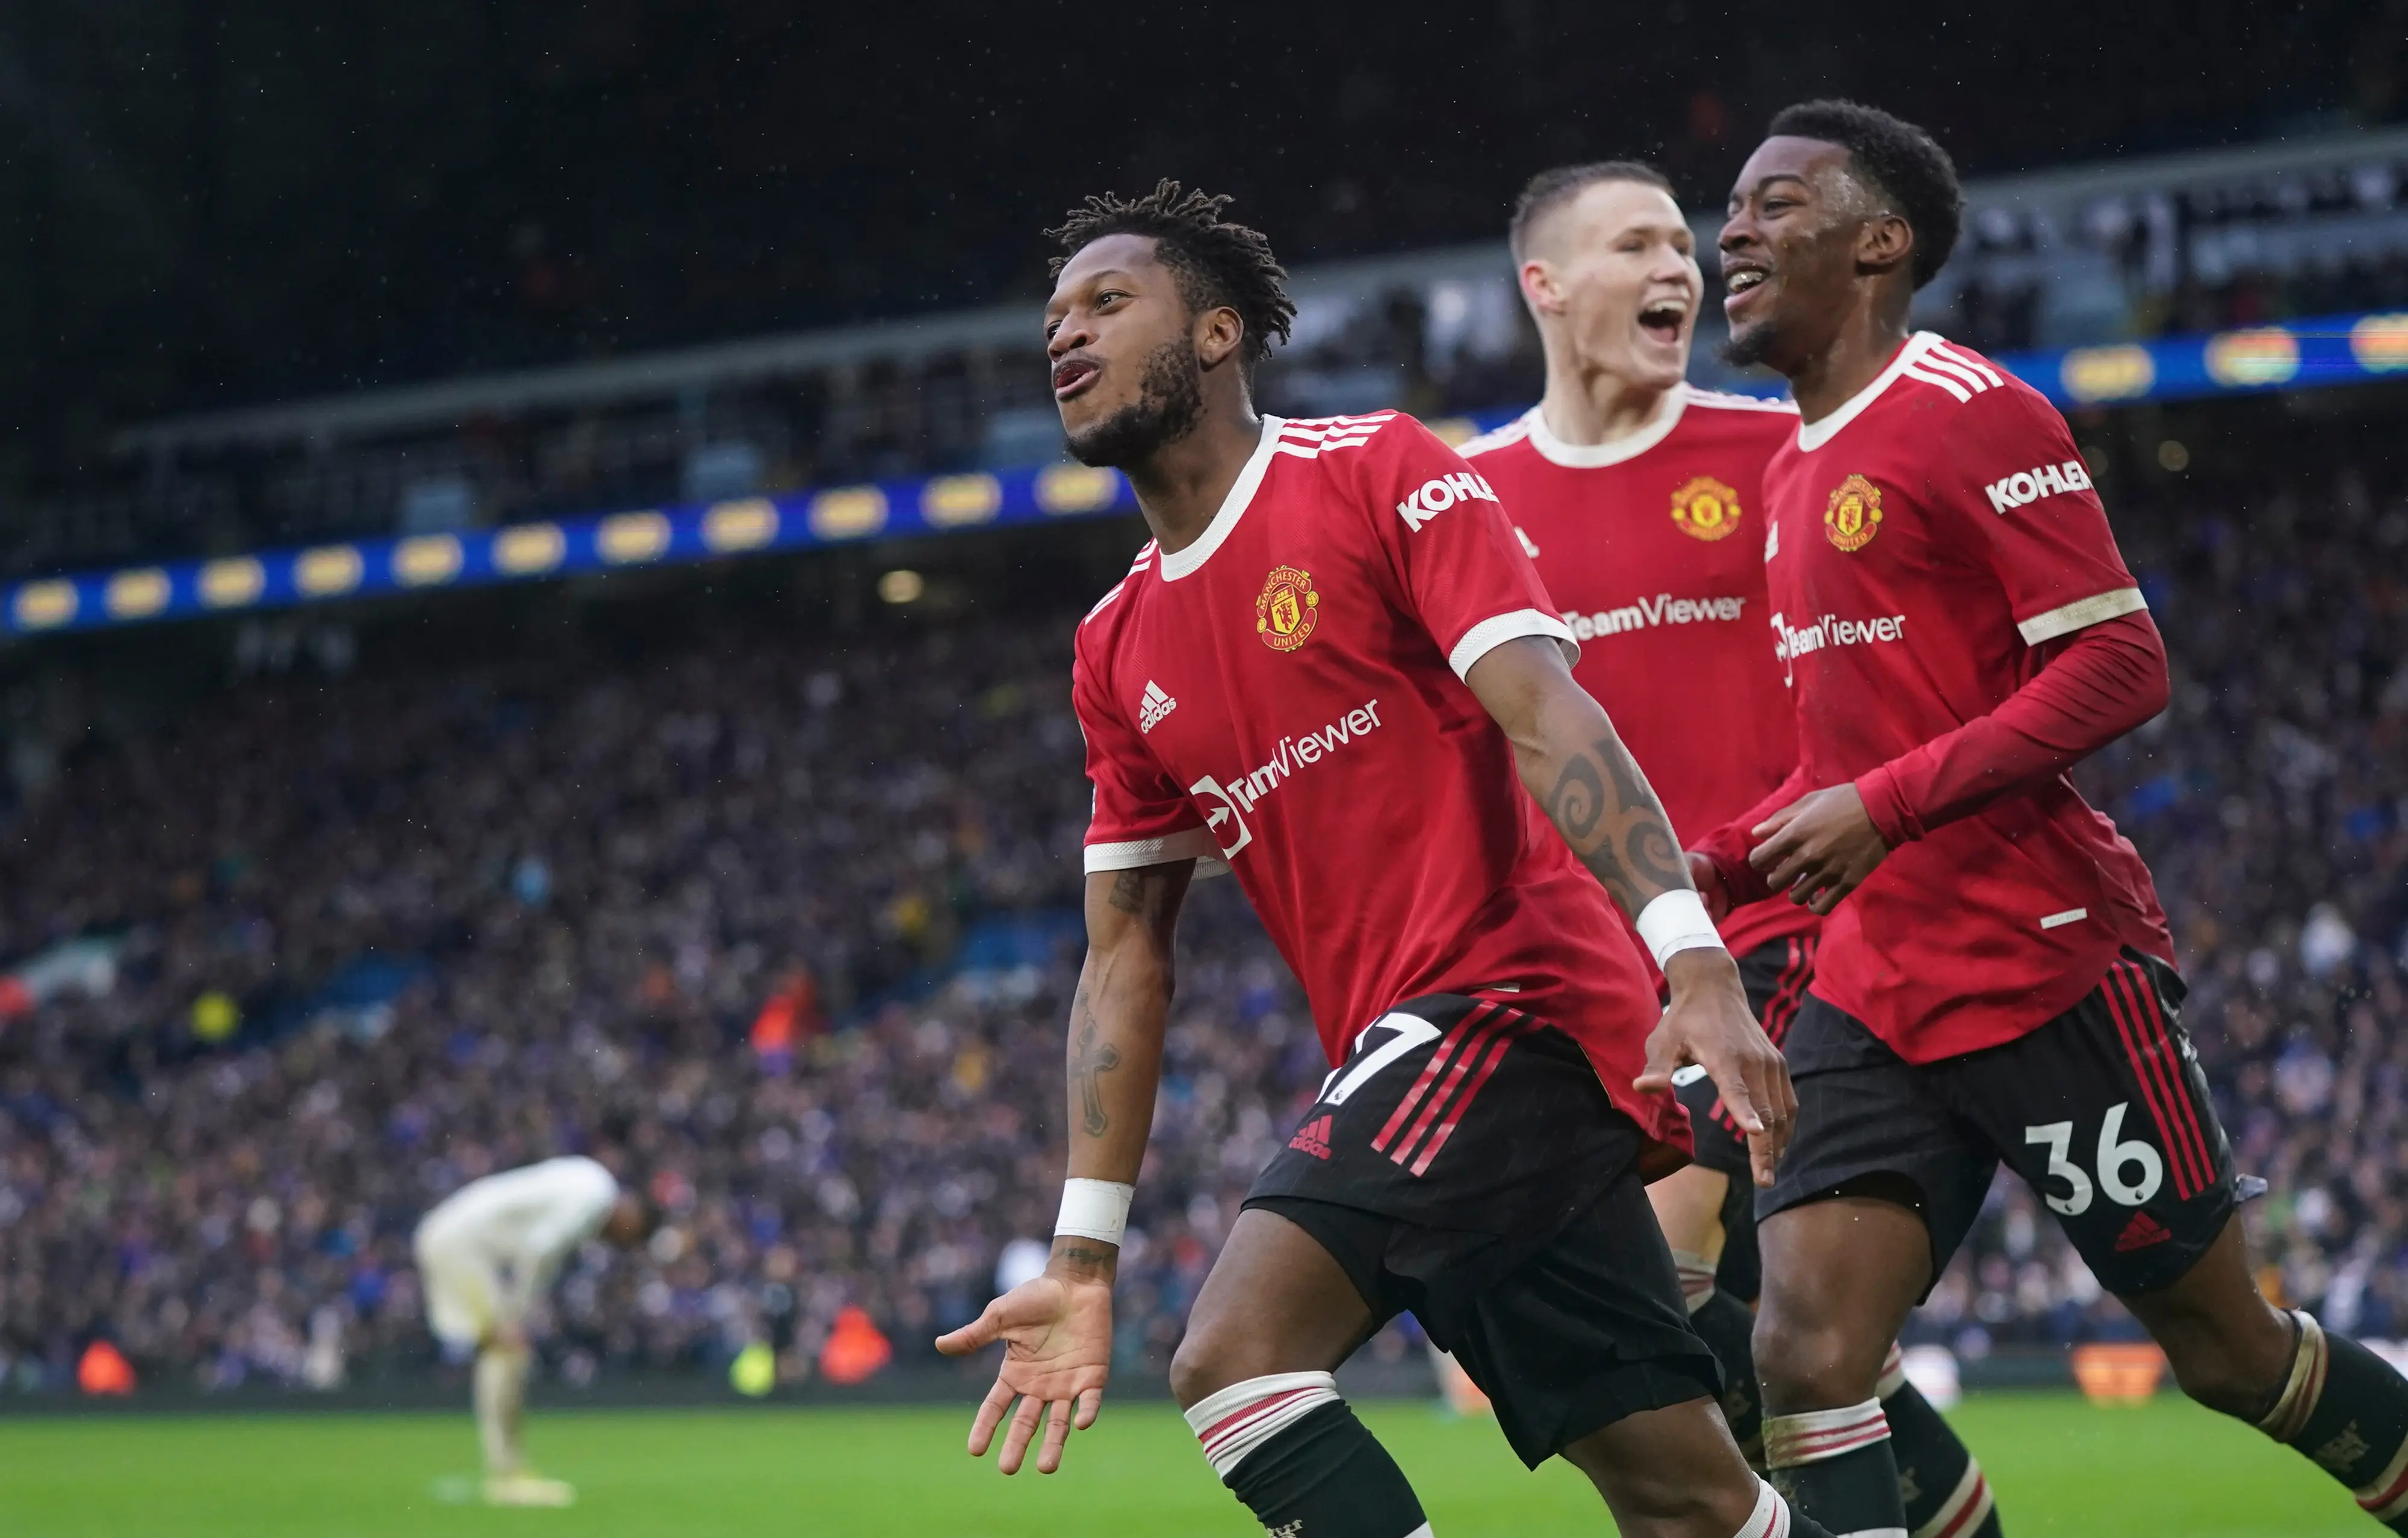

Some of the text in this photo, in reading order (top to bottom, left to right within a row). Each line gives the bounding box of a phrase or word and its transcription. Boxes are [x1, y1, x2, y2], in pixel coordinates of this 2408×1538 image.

[1259, 571, 1307, 610] MANCHESTER
[1273, 622, 1310, 647] UNITED
[1141, 696, 1177, 734] adidas
[2025, 1102, 2164, 1217] 36
